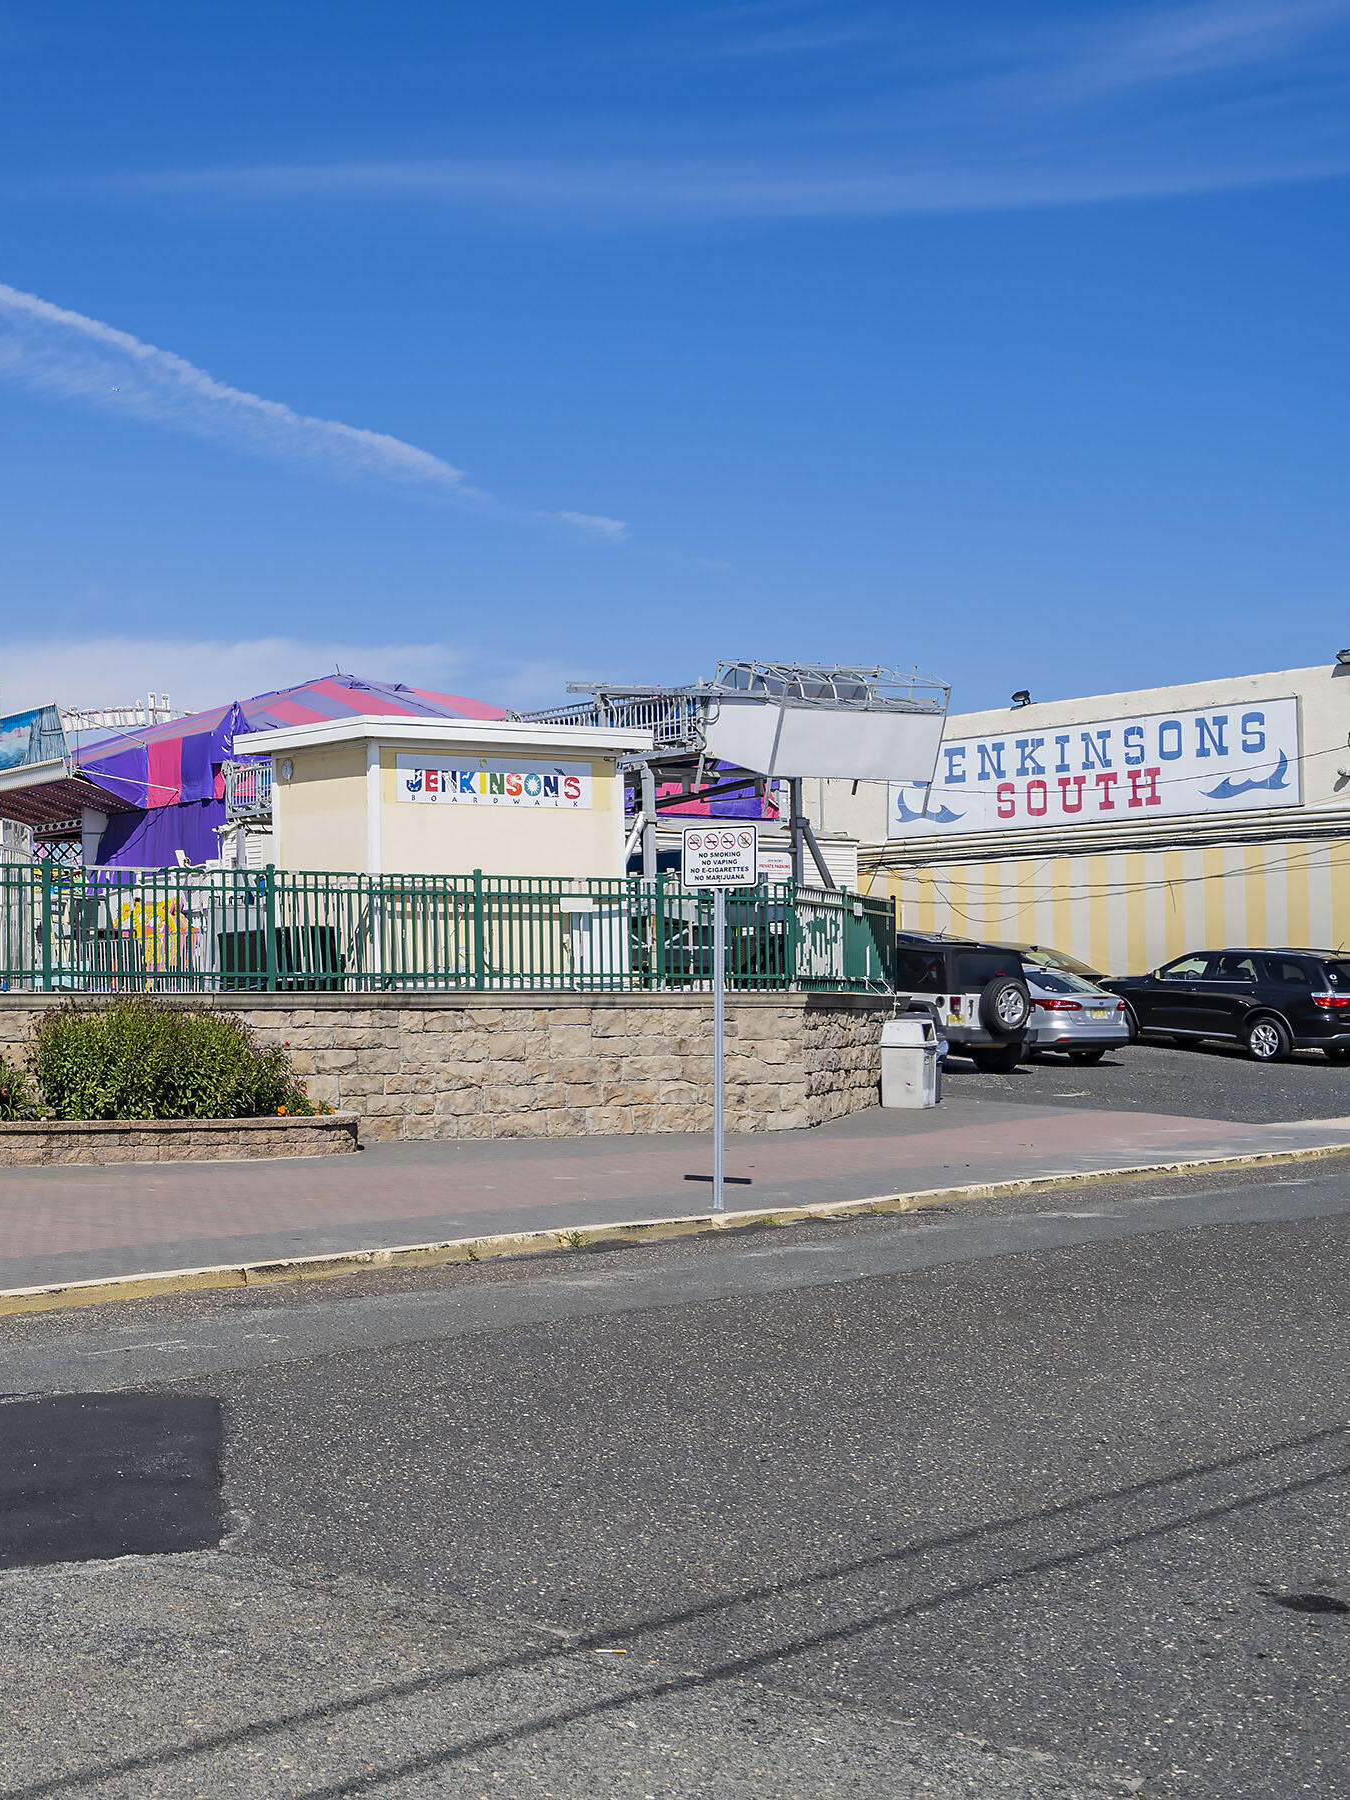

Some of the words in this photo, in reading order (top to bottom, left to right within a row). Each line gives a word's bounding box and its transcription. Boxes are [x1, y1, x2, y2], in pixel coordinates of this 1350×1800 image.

[912, 711, 1267, 788] ENKINSONS
[406, 768, 581, 800] JENKINSON'S
[411, 794, 578, 808] BOARDWALK
[997, 766, 1162, 819] SOUTH
